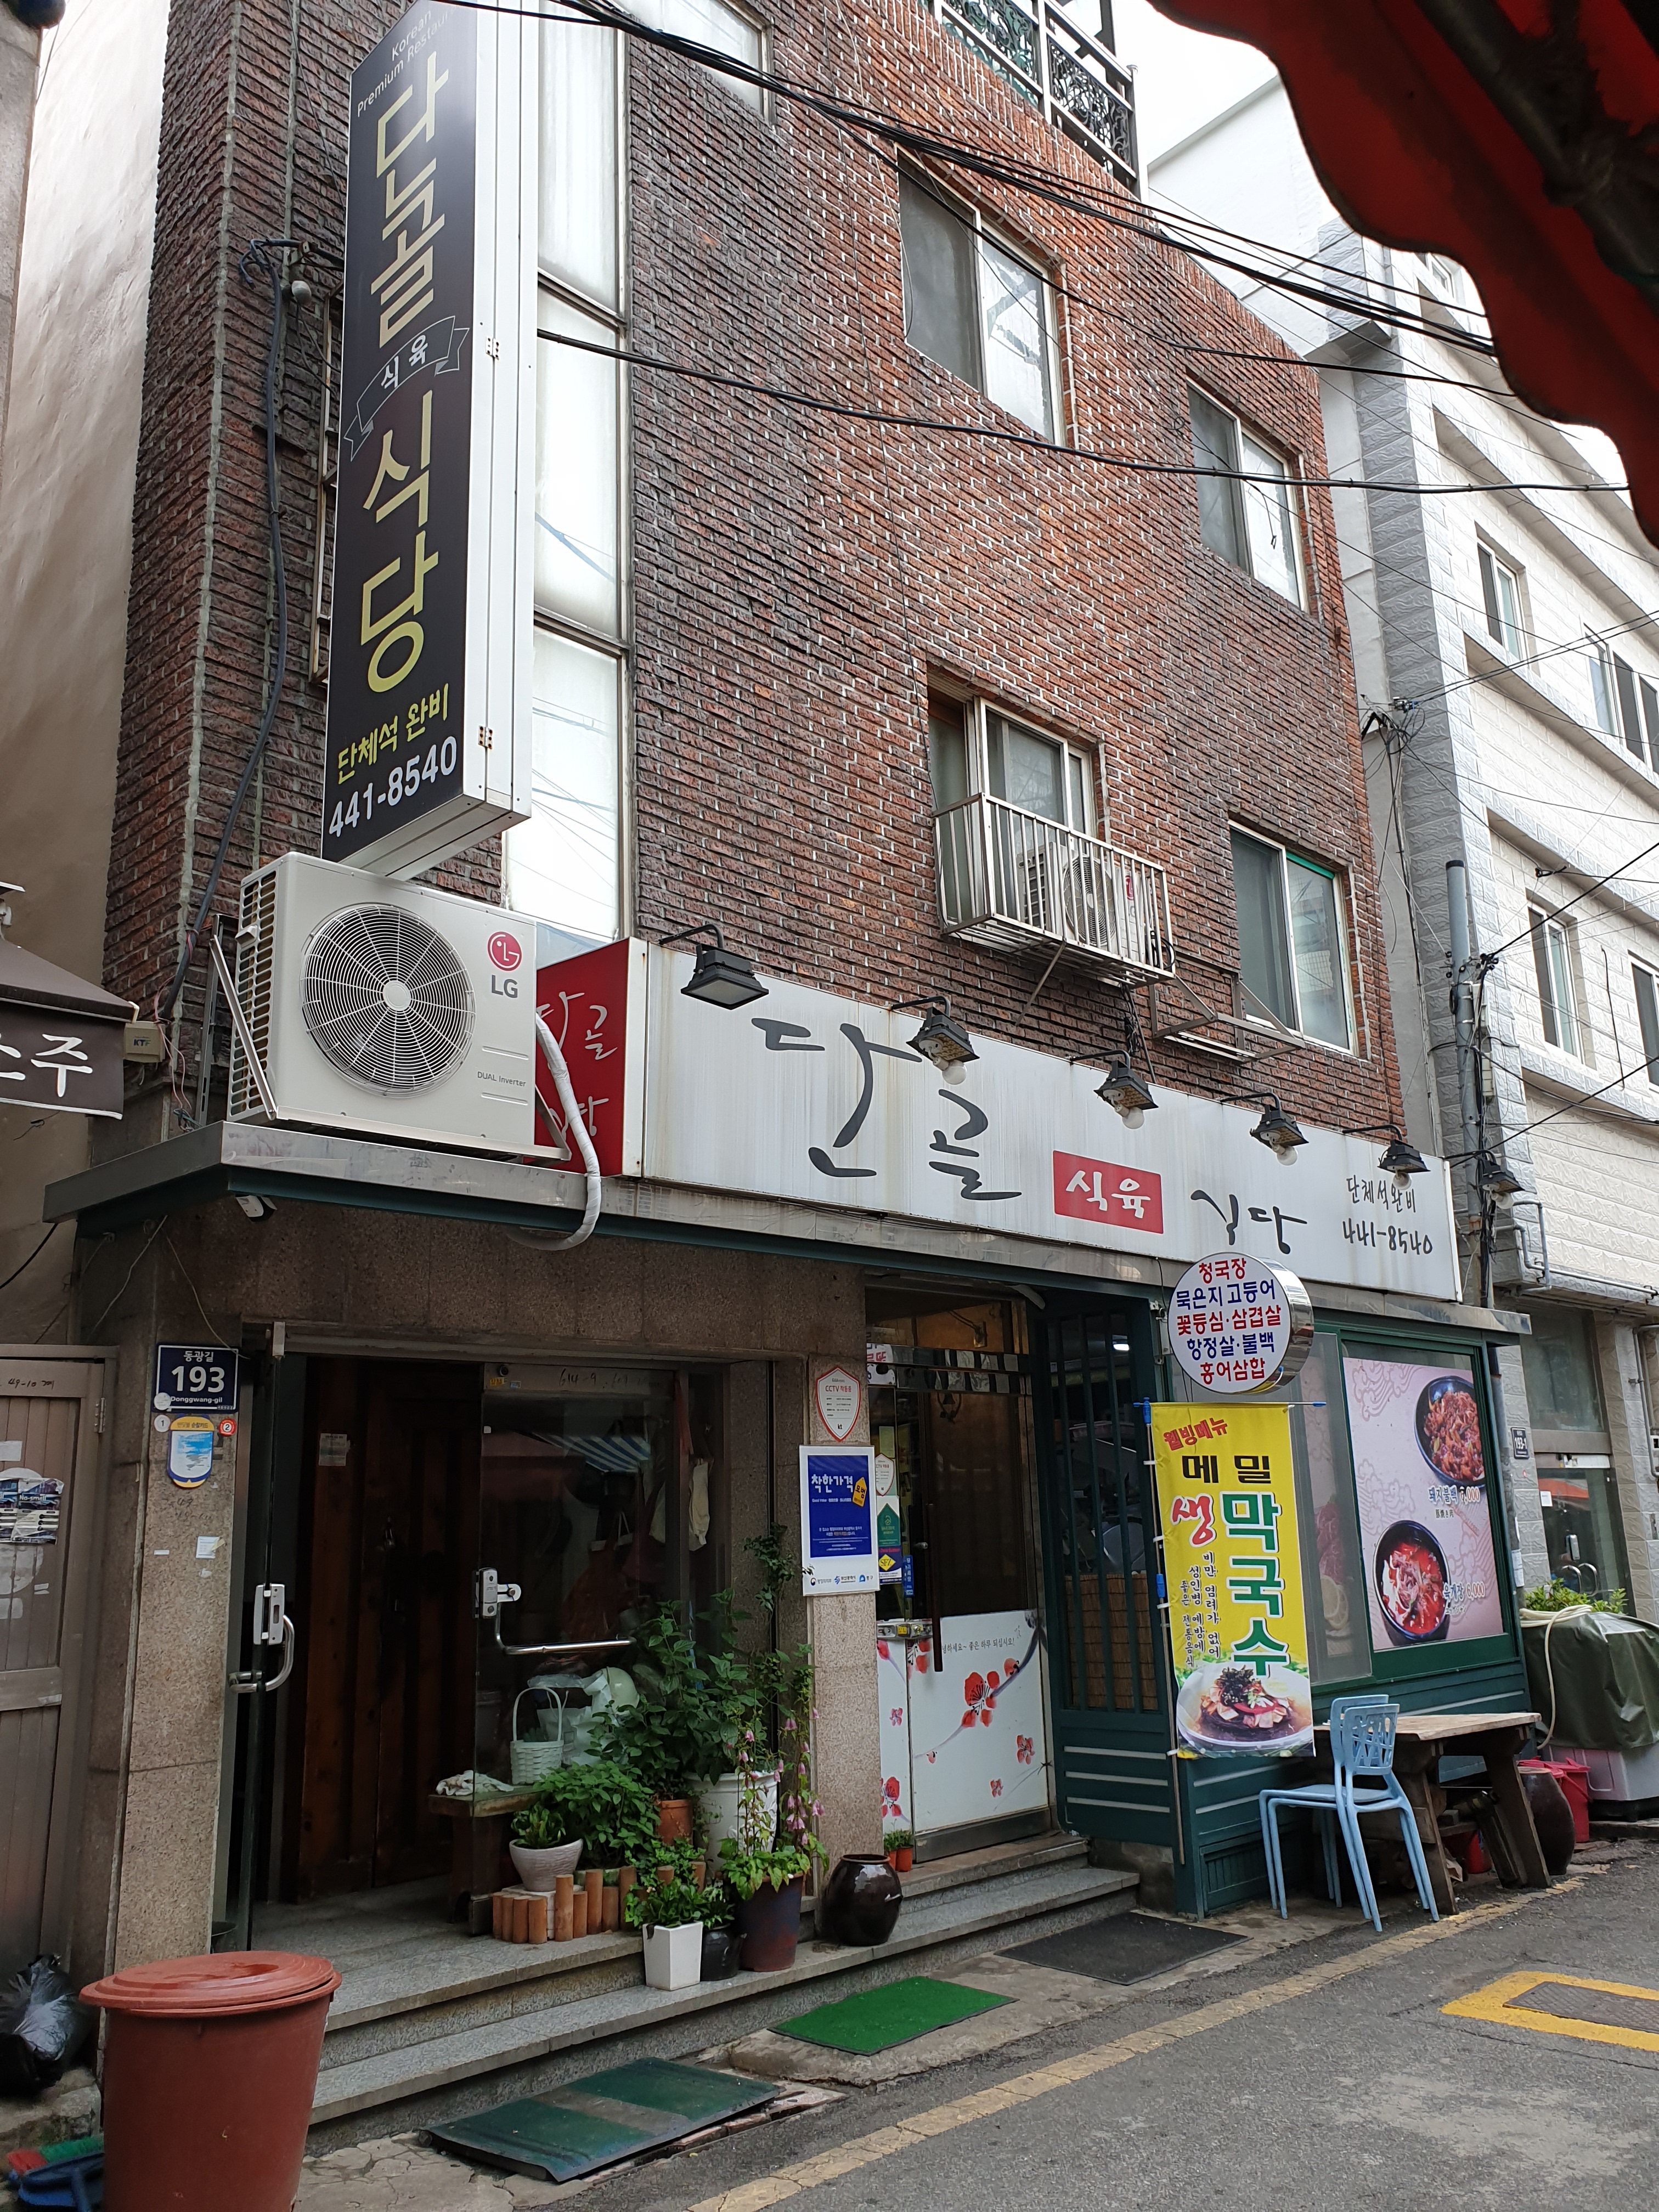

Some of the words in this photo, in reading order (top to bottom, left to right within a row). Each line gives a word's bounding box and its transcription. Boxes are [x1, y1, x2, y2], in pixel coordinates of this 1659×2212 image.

[392, 10, 431, 61] Korean
[357, 59, 403, 117] Premium
[371, 51, 449, 348] 단골
[381, 335, 428, 390] 식육
[361, 390, 439, 692] 식당
[338, 715, 398, 785] 단체석
[406, 683, 449, 742] 완비
[329, 736, 457, 837] 441-8540
[492, 974, 518, 998] LG
[477, 1071, 497, 1082] DUAL
[499, 1075, 527, 1087] Inverter
[751, 1017, 1022, 1201] 단골
[1065, 1170, 1151, 1220] 식육
[1342, 1217, 1433, 1255] 441-8540
[1199, 1257, 1247, 1284] 청국장
[1176, 1286, 1223, 1310] 묵은지
[1227, 1279, 1276, 1305] 고등어
[183, 1351, 214, 1363] 동광길
[1200, 1357, 1266, 1385] 홍어삼합
[171, 1365, 225, 1393] 193
[1515, 1437, 1527, 1449] 193-1
[811, 1474, 853, 1493] 착한가격
[855, 1485, 866, 1499] 모범
[1203, 1551, 1217, 1577] 비만
[1172, 1494, 1214, 1547] 생
[1221, 1492, 1289, 1677] 막국수
[1180, 1580, 1189, 1606] 좋은
[1189, 1565, 1202, 1605] 성인병
[1443, 1582, 1464, 1602] 육개장
[1466, 1581, 1486, 1601] 6,000
[1205, 1585, 1219, 1625] 염려가
[969, 1641, 979, 1651] 좋은
[981, 1640, 991, 1649] 하루
[993, 1638, 1015, 1647] 되십시오!
[1192, 1613, 1205, 1652] 예방에
[1208, 1632, 1221, 1658] 없어
